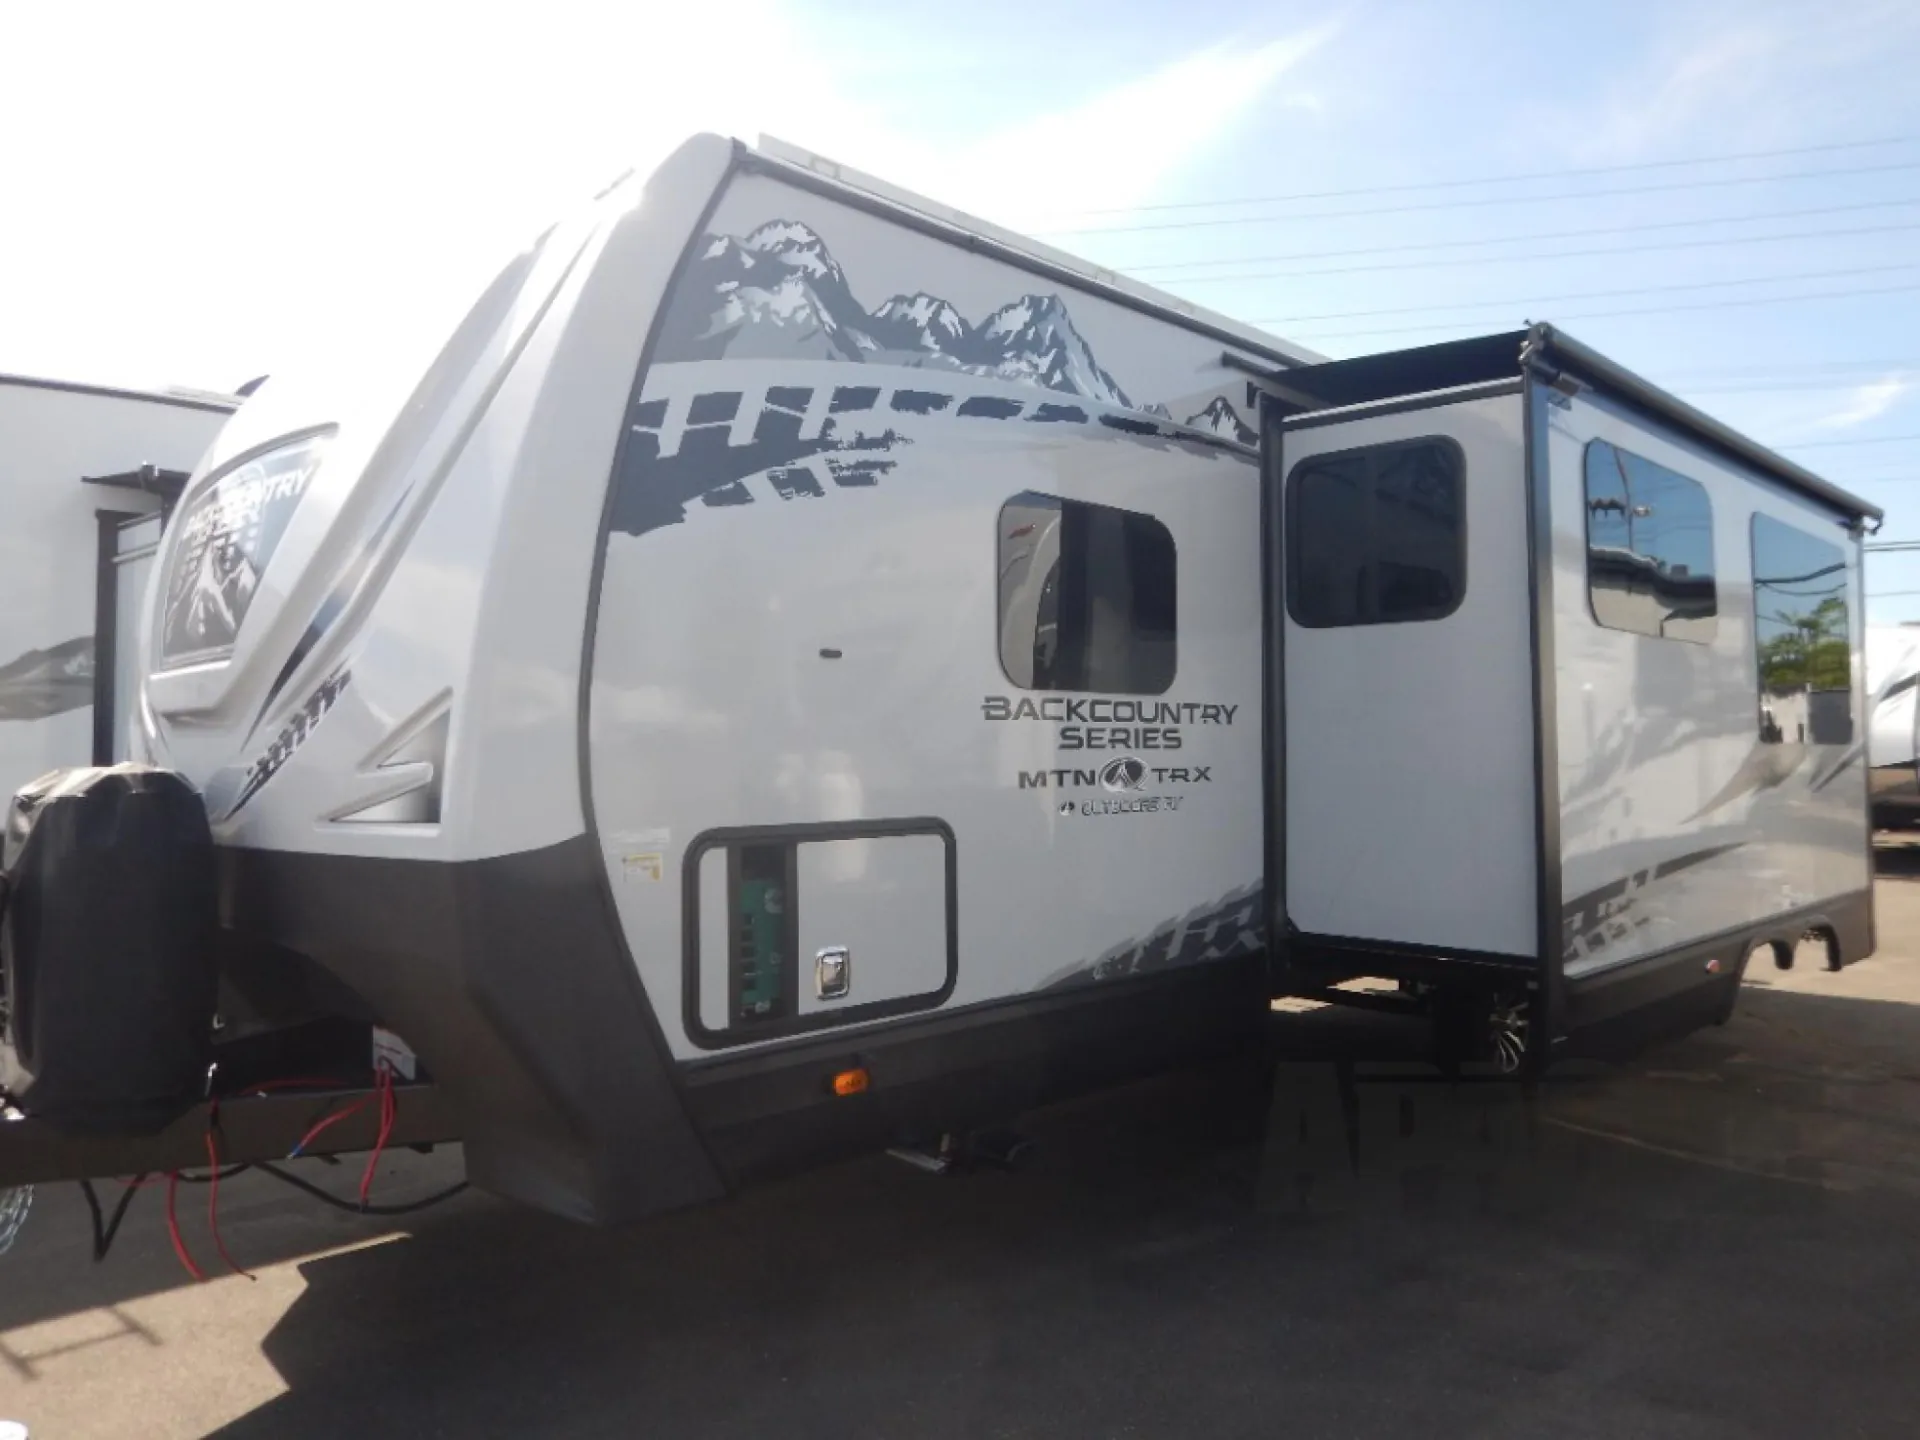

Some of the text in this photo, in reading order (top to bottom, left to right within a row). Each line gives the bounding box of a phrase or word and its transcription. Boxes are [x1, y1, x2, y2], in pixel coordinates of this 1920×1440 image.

[981, 696, 1238, 724] BACKCOUNTRY
[1059, 728, 1182, 750] SERIES
[1018, 766, 1213, 789] MTN TRX
